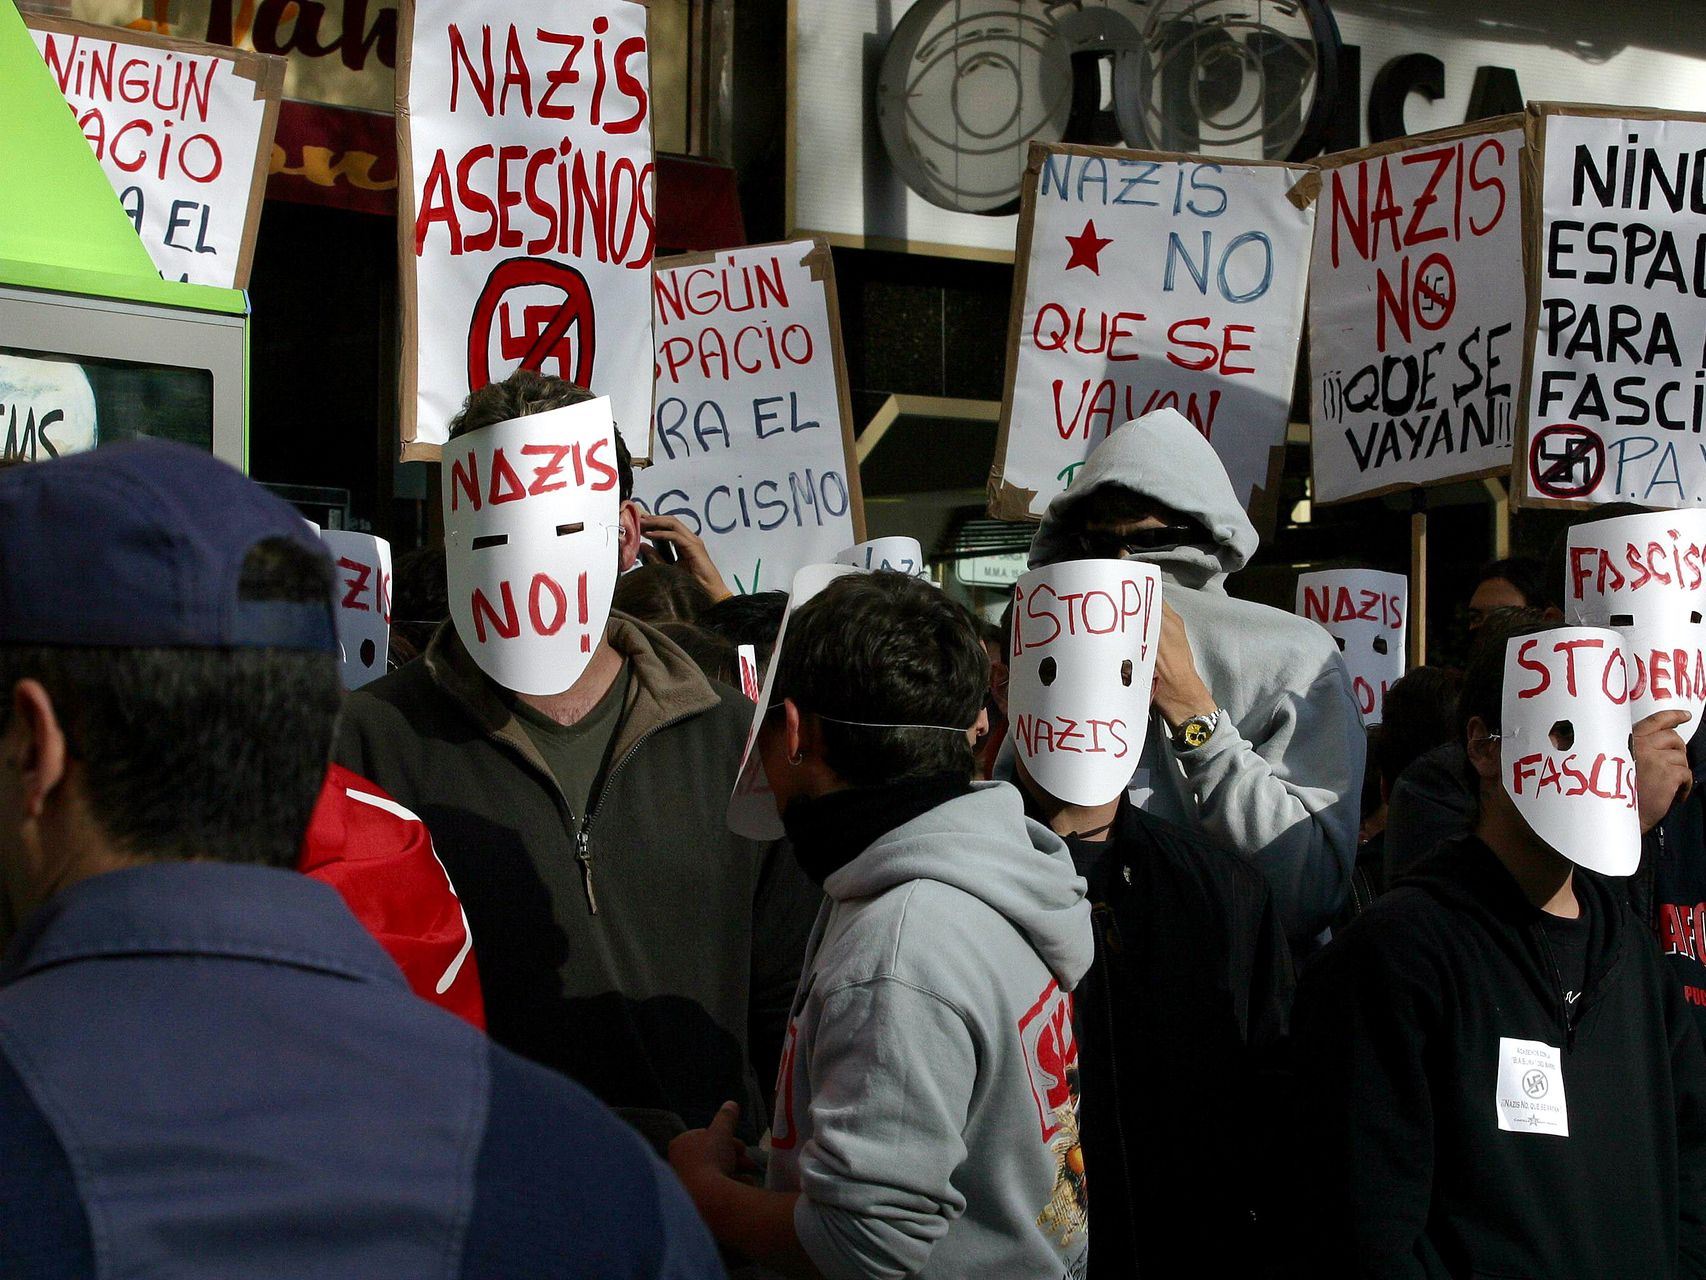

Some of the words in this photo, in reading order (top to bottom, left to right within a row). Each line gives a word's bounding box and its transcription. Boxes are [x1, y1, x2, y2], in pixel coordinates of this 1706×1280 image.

[163, 200, 217, 254] EL
[1331, 139, 1505, 268] NAZIS
[1163, 231, 1274, 303] NO
[1376, 252, 1456, 352] NO
[655, 320, 814, 384] PACiO
[1033, 303, 1147, 361] QUE
[1166, 317, 1256, 375] SE
[1452, 322, 1511, 408] SE
[1543, 298, 1682, 366] PARA
[0, 403, 64, 462] MS
[657, 397, 730, 459] RA
[753, 391, 820, 438] EL
[452, 438, 618, 514] NAZIS
[1608, 436, 1706, 501] P.A.
[1570, 528, 1706, 602] FASCiS
[471, 571, 590, 653] NO!
[1014, 576, 1154, 661] ¡STOP!
[1304, 585, 1403, 629] NAZIS
[1015, 714, 1127, 758] NAZIS
[1513, 753, 1638, 809] FASCIS
